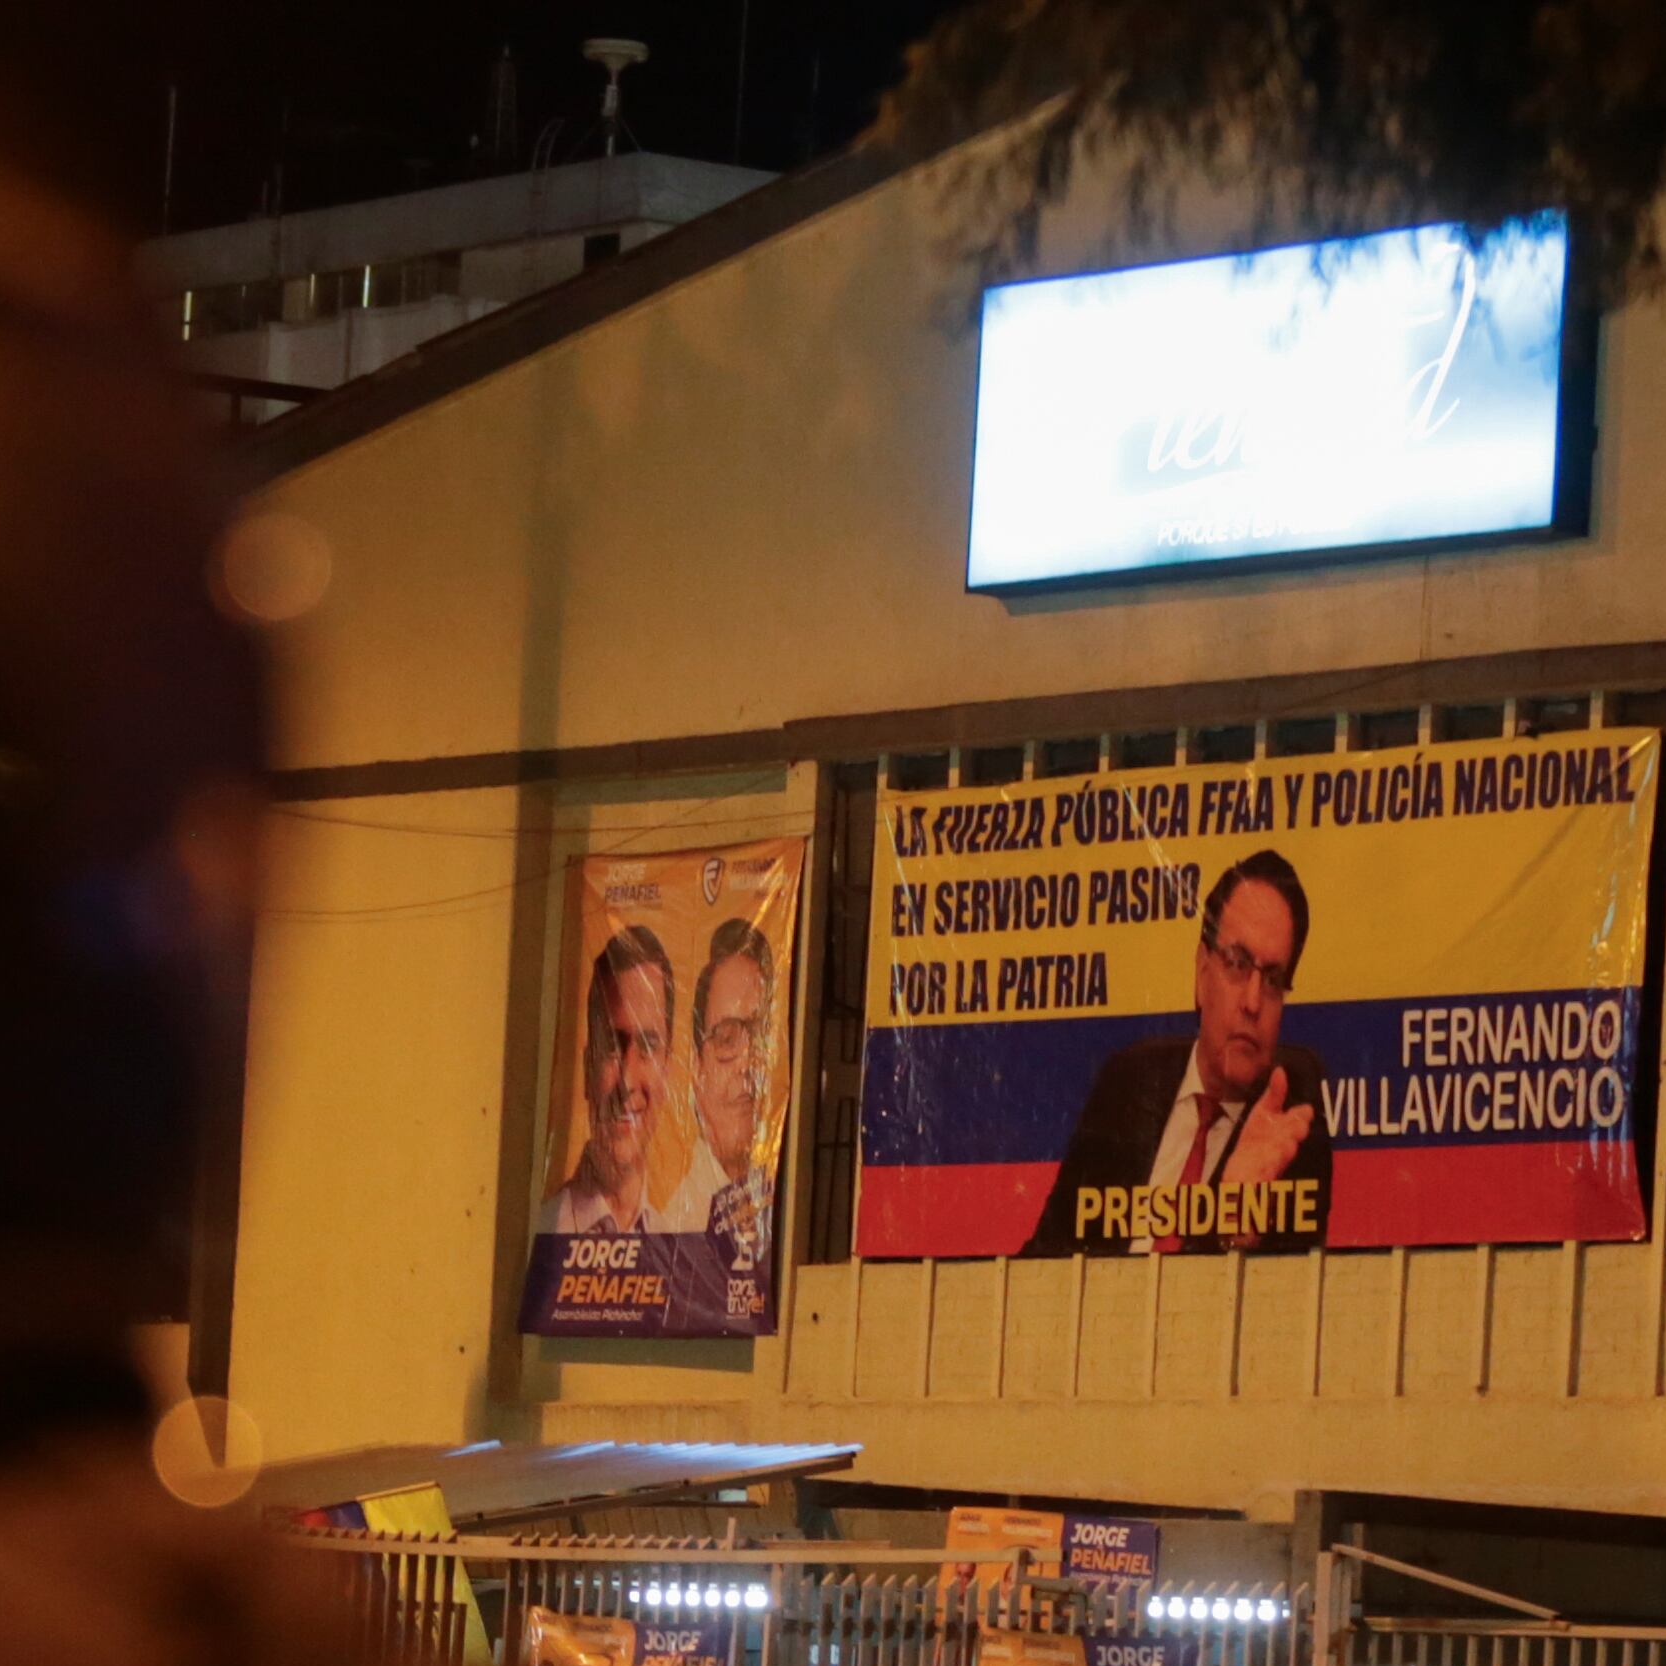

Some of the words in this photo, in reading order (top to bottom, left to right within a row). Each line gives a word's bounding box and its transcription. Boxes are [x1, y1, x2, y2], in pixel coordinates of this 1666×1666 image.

[894, 805, 927, 857] LA
[932, 797, 1045, 855] FUERZA
[1051, 780, 1189, 847] PÚBLICA
[1198, 776, 1274, 835] FFAA
[1284, 771, 1304, 829] Y
[1311, 753, 1443, 827] POLICÍA
[1453, 744, 1637, 816] NACIONAL
[892, 883, 927, 937] EN
[934, 873, 1080, 935] SERVICIO
[1088, 863, 1201, 925] PASIVO
[889, 962, 947, 1016] POR
[955, 959, 989, 1013] LA
[997, 952, 1108, 1011] PATRIA
[1402, 1000, 1622, 1068] FERNANDO
[1321, 1066, 1624, 1138] VILLAVICENCIO
[1075, 1179, 1319, 1238] PRESIDENTE
[563, 1240, 640, 1269] JORGE
[557, 1268, 667, 1304] PEÑAFIEL
[1070, 1522, 1130, 1547] JORGE
[1070, 1545, 1152, 1575] PEÑAFIEL
[644, 1630, 702, 1652] JORGE
